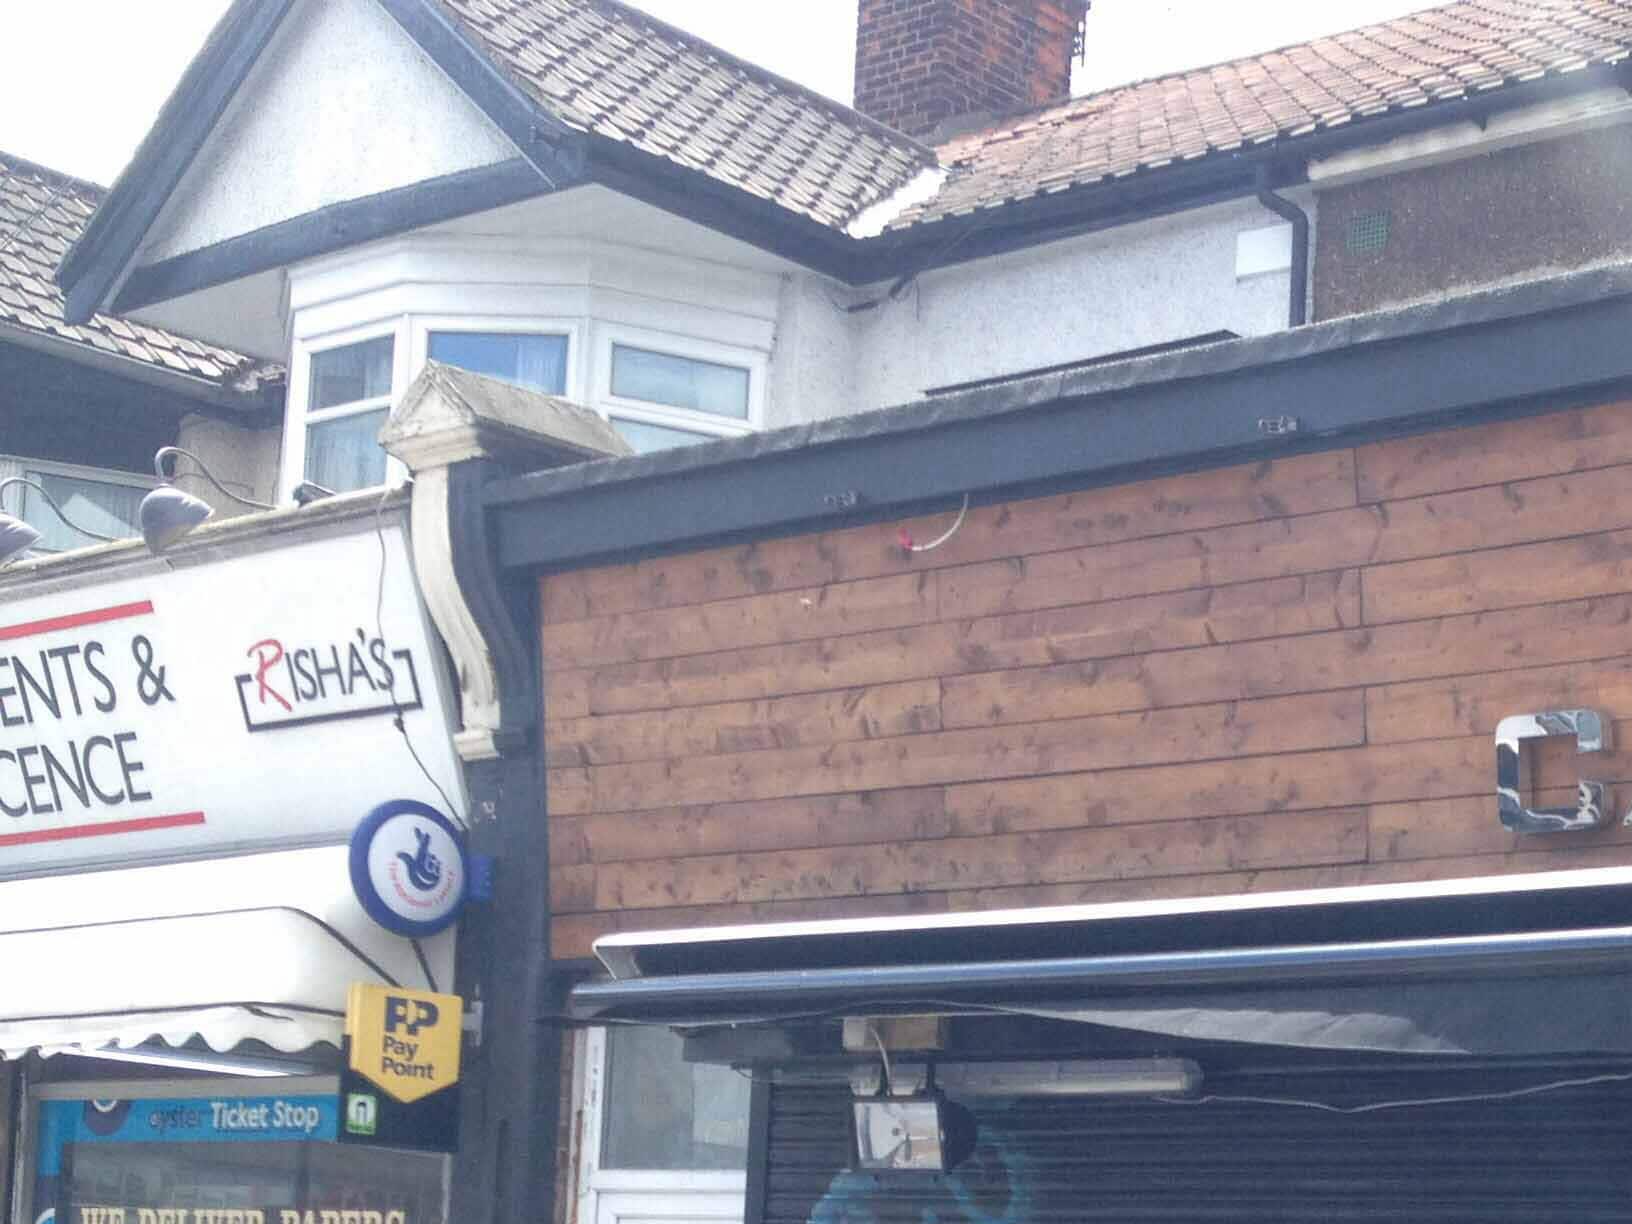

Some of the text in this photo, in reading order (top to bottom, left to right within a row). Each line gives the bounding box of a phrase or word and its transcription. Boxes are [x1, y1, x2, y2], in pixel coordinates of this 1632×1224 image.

[131, 634, 177, 706] &
[247, 627, 396, 713] RISHA'S
[381, 1034, 419, 1062] Pay
[380, 1055, 436, 1081] Point
[210, 1101, 268, 1129] Ticket
[272, 1099, 320, 1134] Stop
